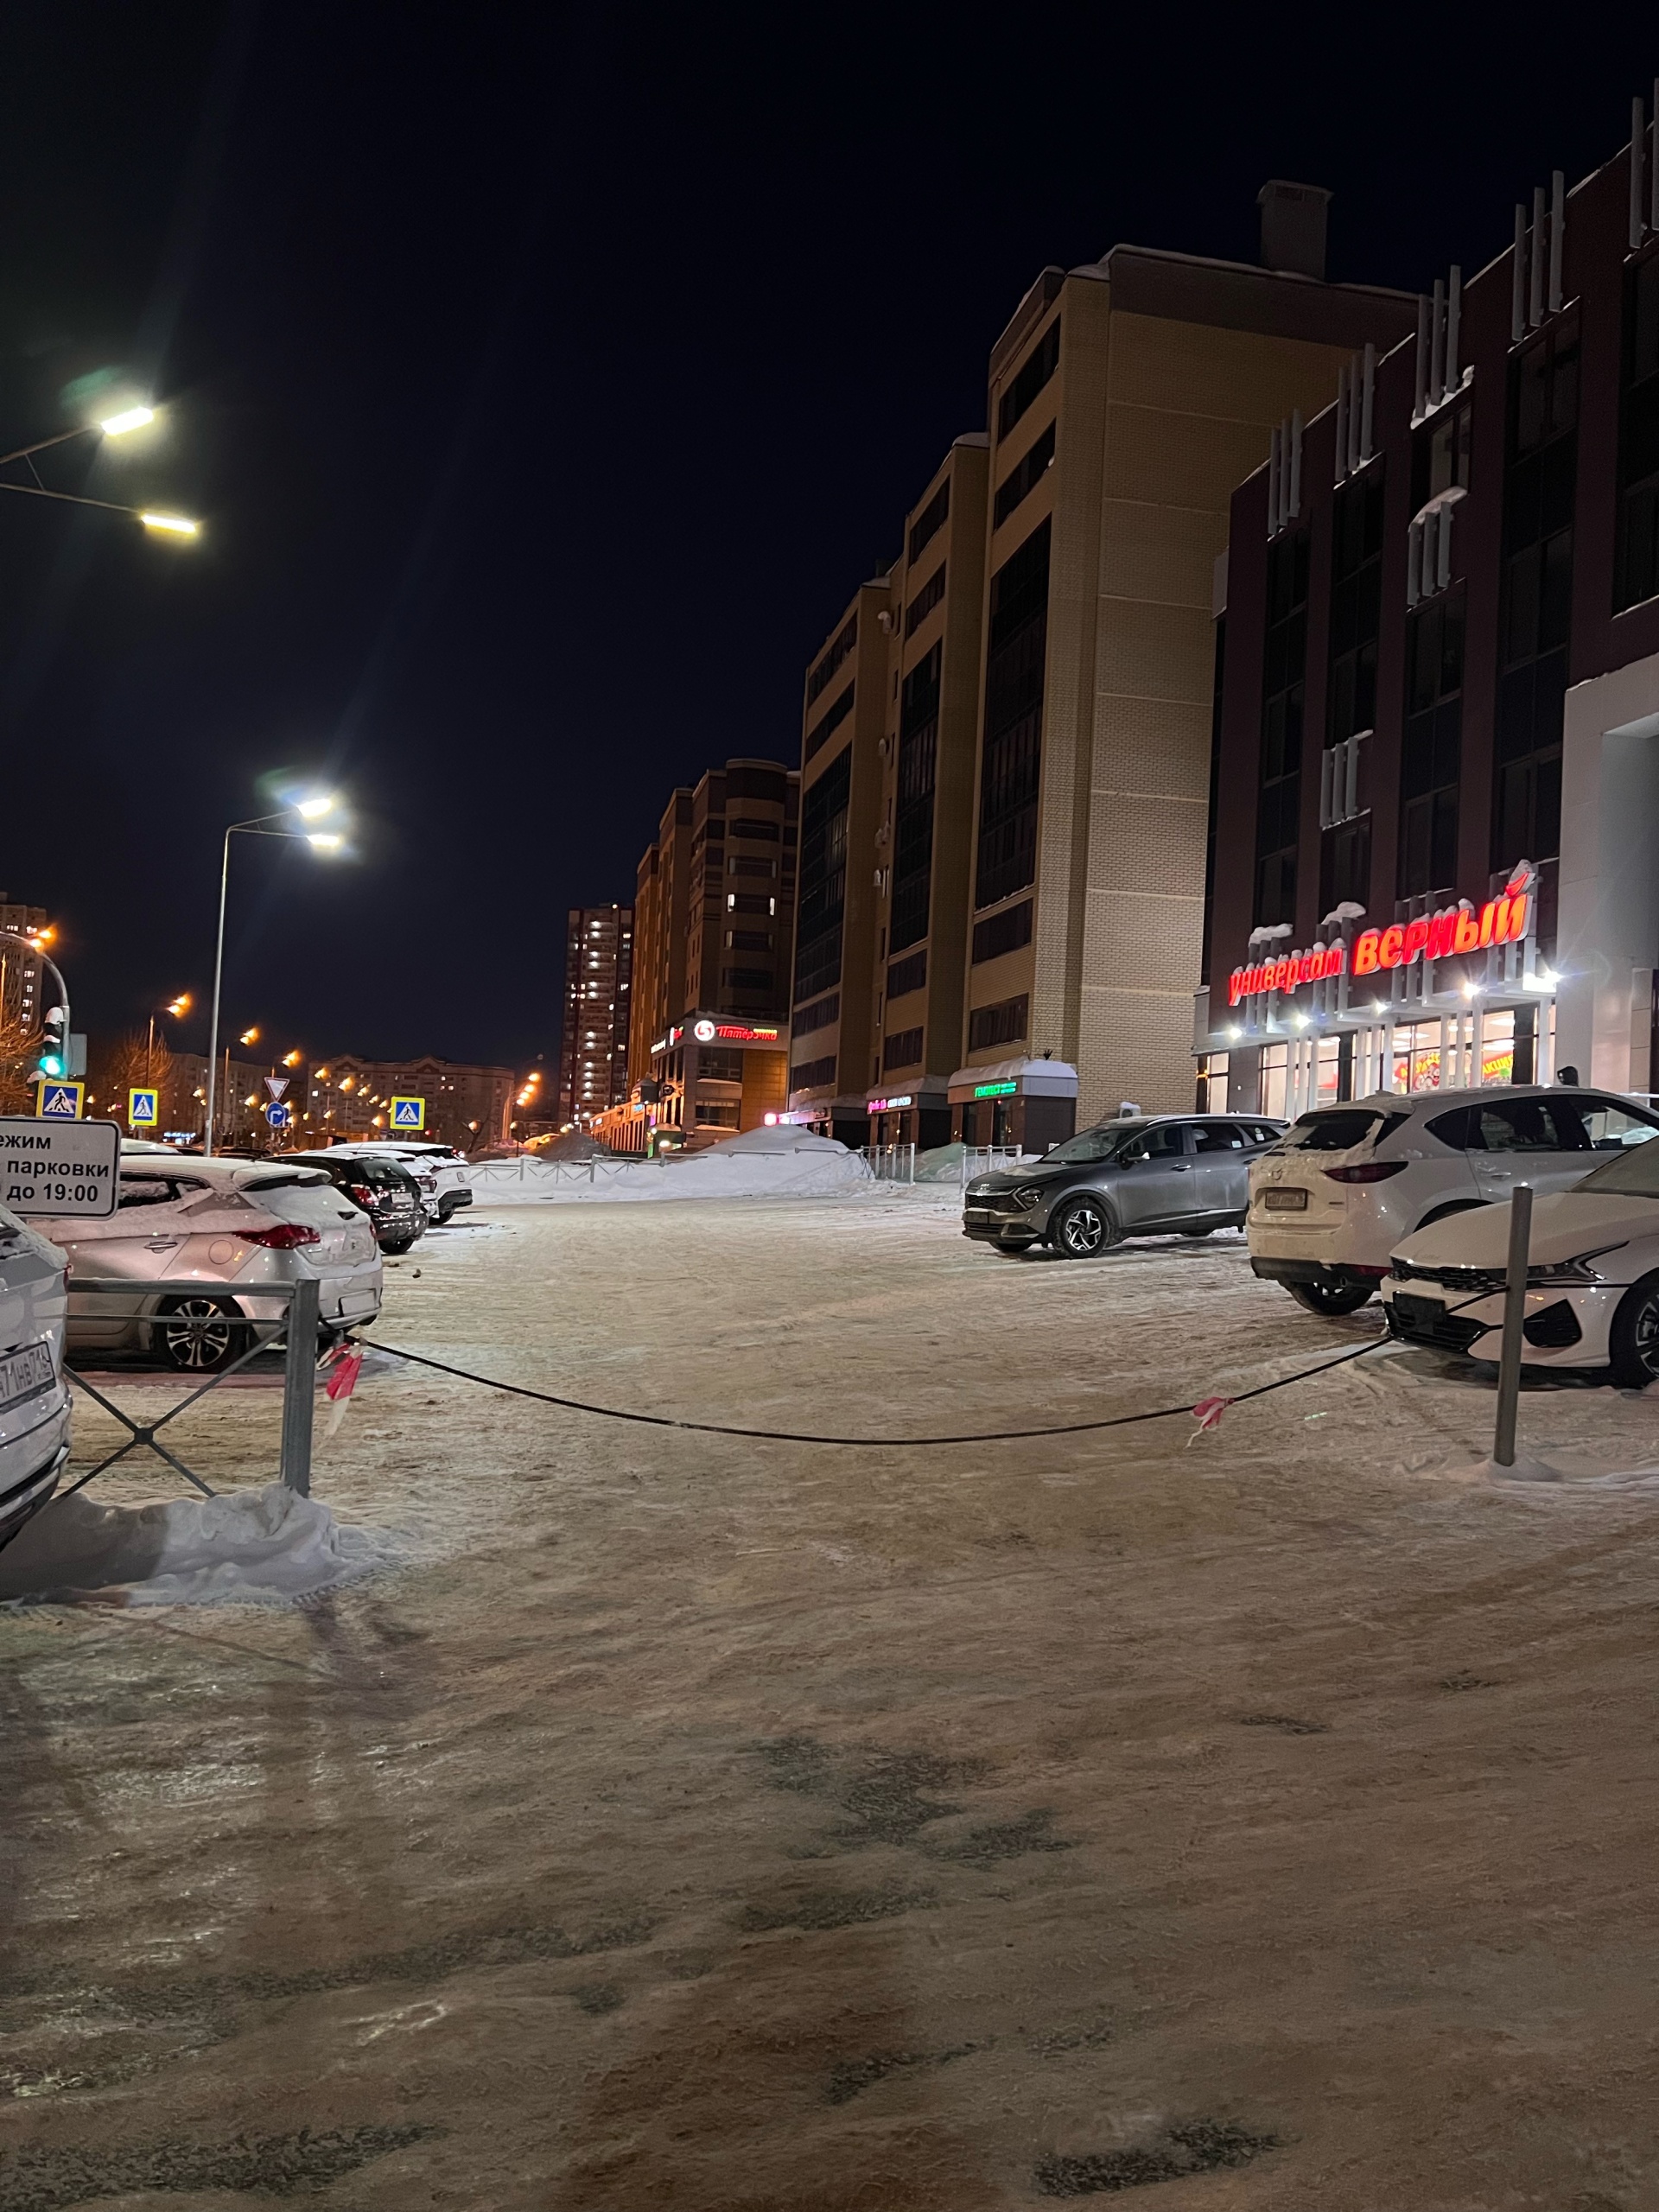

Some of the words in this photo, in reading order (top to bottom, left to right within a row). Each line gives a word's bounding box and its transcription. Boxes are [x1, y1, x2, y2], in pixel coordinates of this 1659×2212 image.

[1228, 948, 1344, 1007] универсам
[7, 1160, 110, 1179] парковки
[6, 1185, 35, 1202] до
[43, 1183, 99, 1203] 19:00
